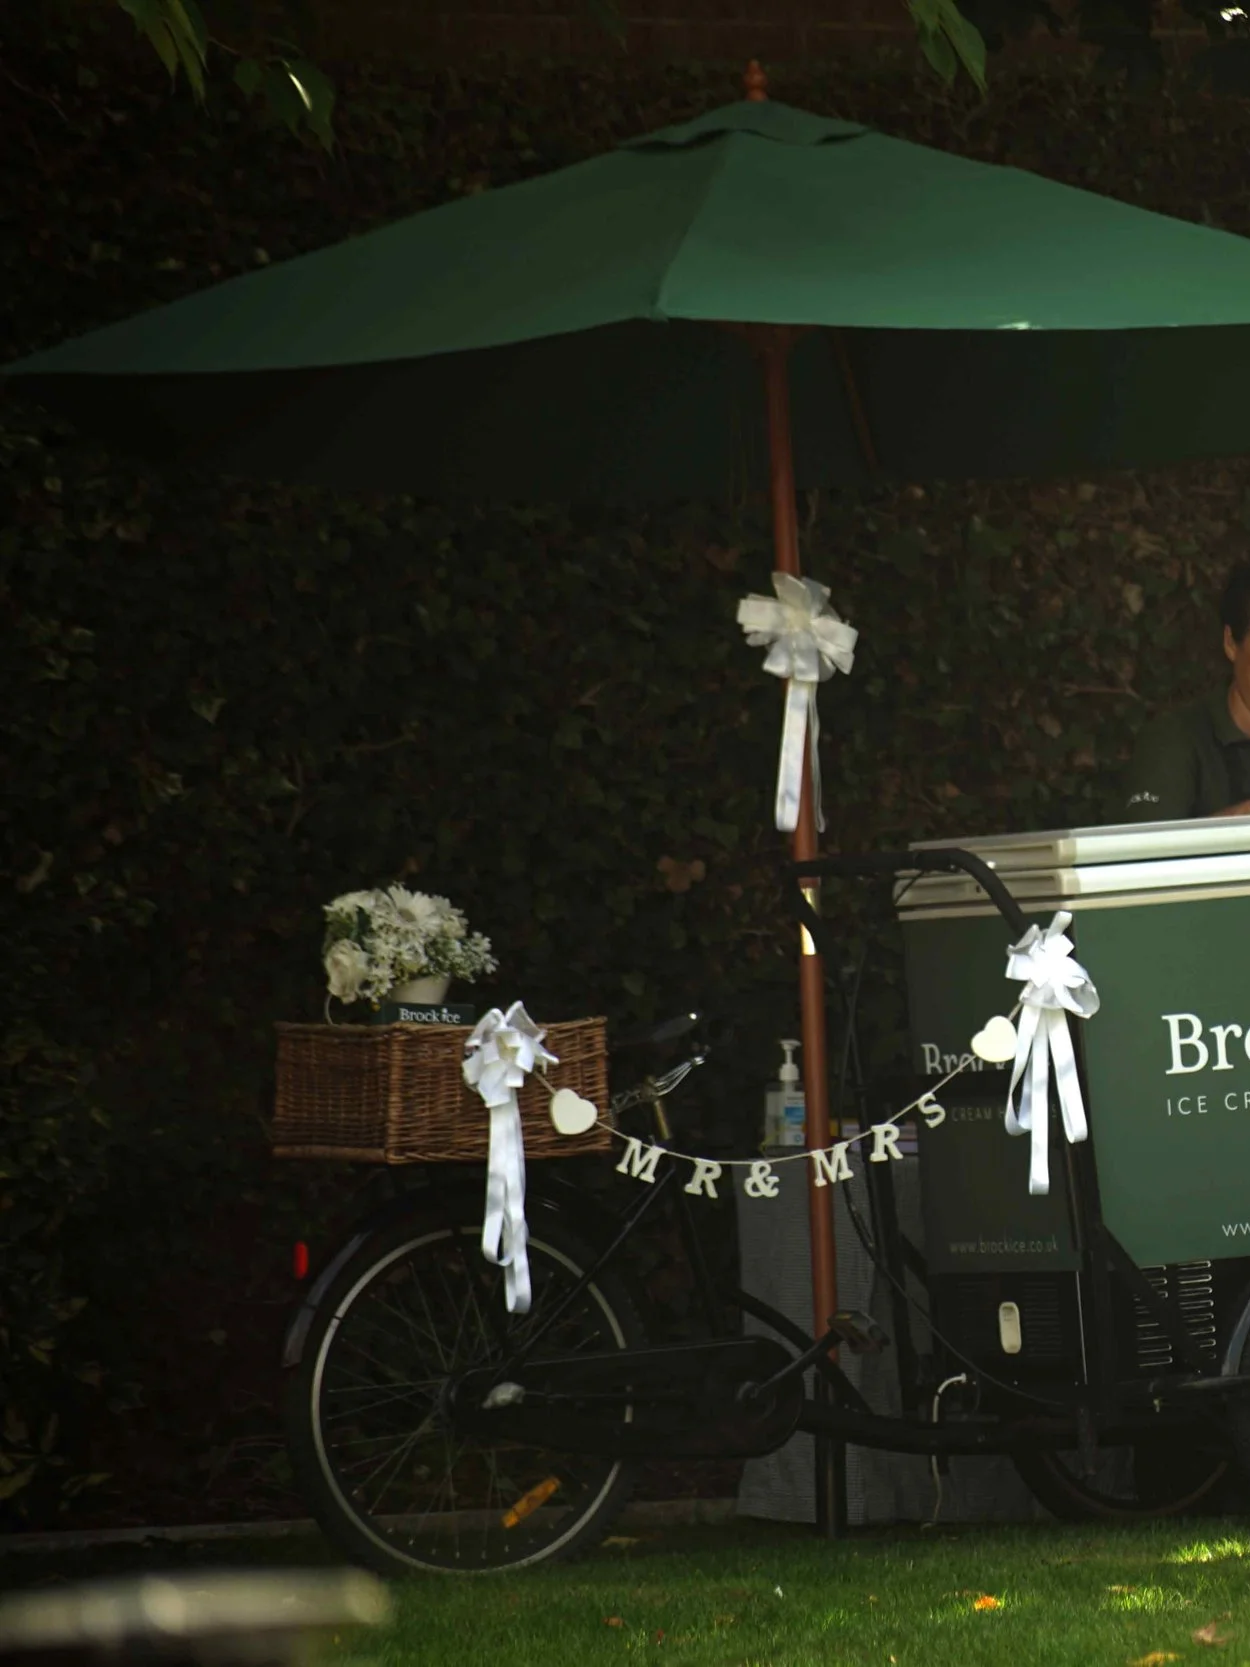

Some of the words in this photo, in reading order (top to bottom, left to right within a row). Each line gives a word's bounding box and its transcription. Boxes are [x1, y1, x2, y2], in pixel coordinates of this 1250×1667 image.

[399, 1008, 440, 1023] Brock
[1166, 1095, 1208, 1117] ICE
[744, 1161, 779, 1198] &
